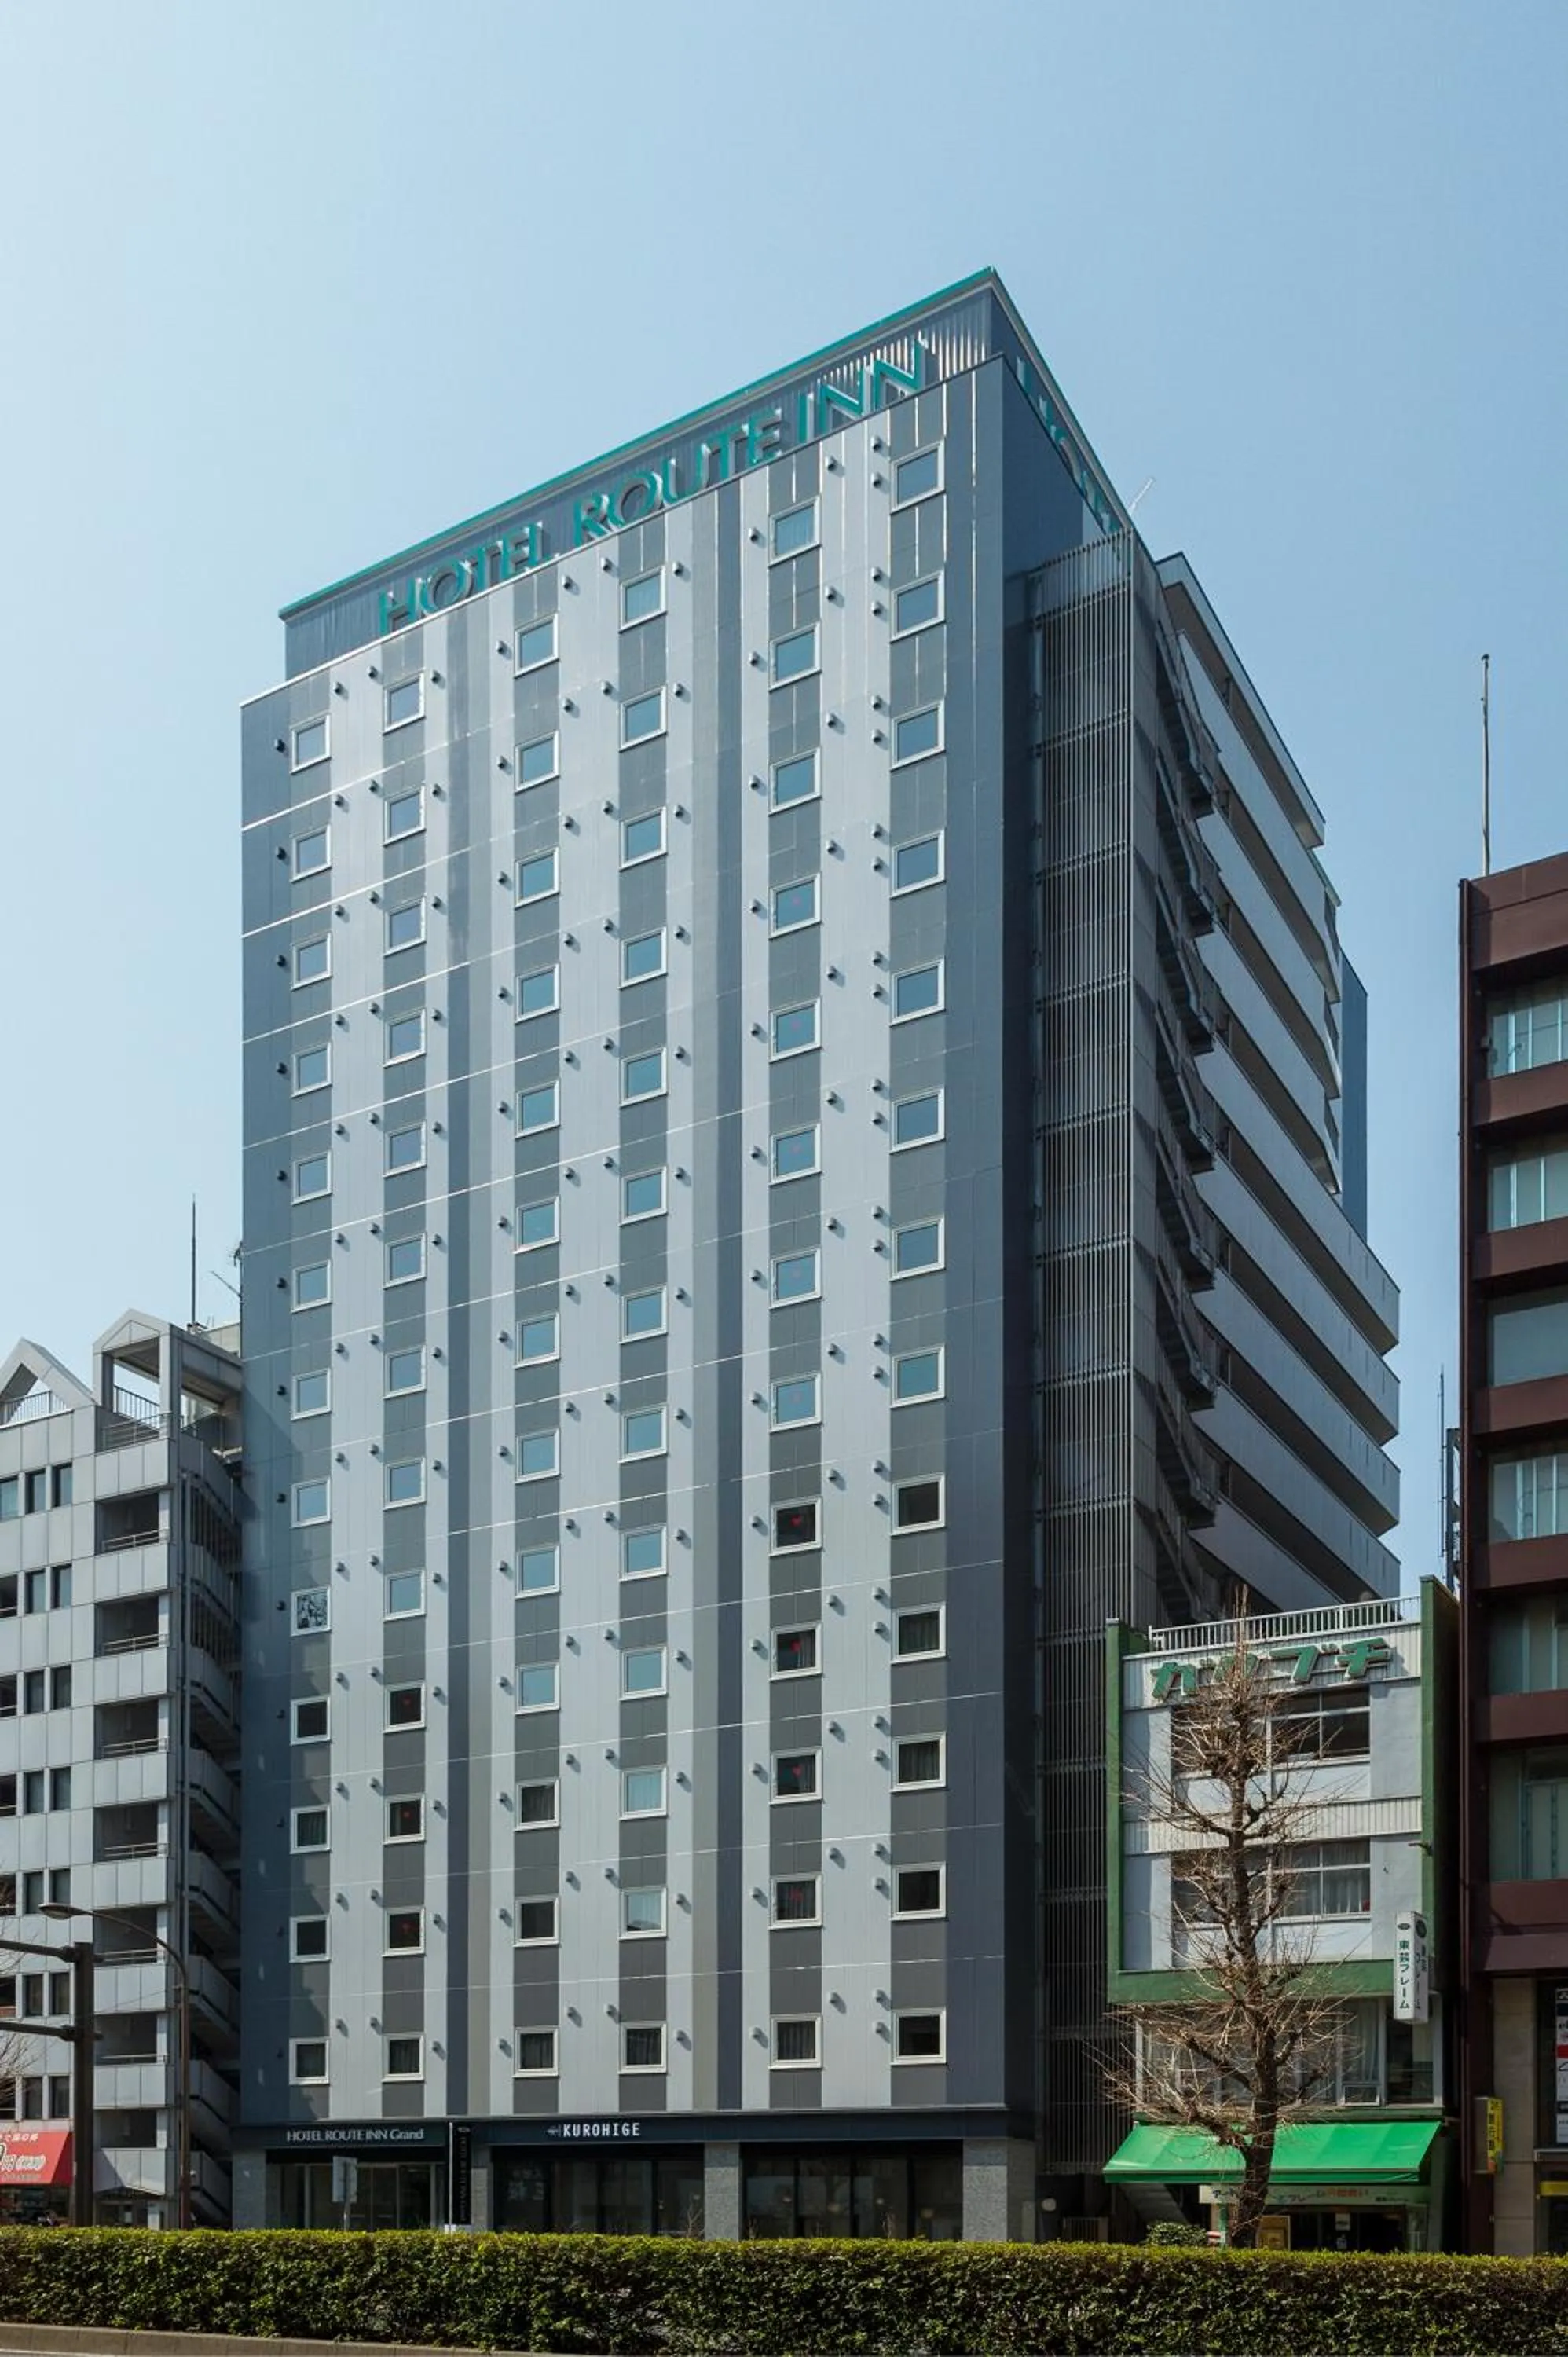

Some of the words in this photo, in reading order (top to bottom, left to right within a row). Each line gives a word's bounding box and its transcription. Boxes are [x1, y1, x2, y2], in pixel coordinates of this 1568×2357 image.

[379, 520, 555, 635] HOTEL
[573, 406, 782, 548] ROUTE
[799, 338, 926, 443] INN
[286, 2129, 323, 2143] HOTEL
[325, 2129, 365, 2141] ROUTE
[366, 2128, 387, 2140] INN
[389, 2128, 425, 2140] Grand
[563, 2122, 640, 2137] KUROHIGE
